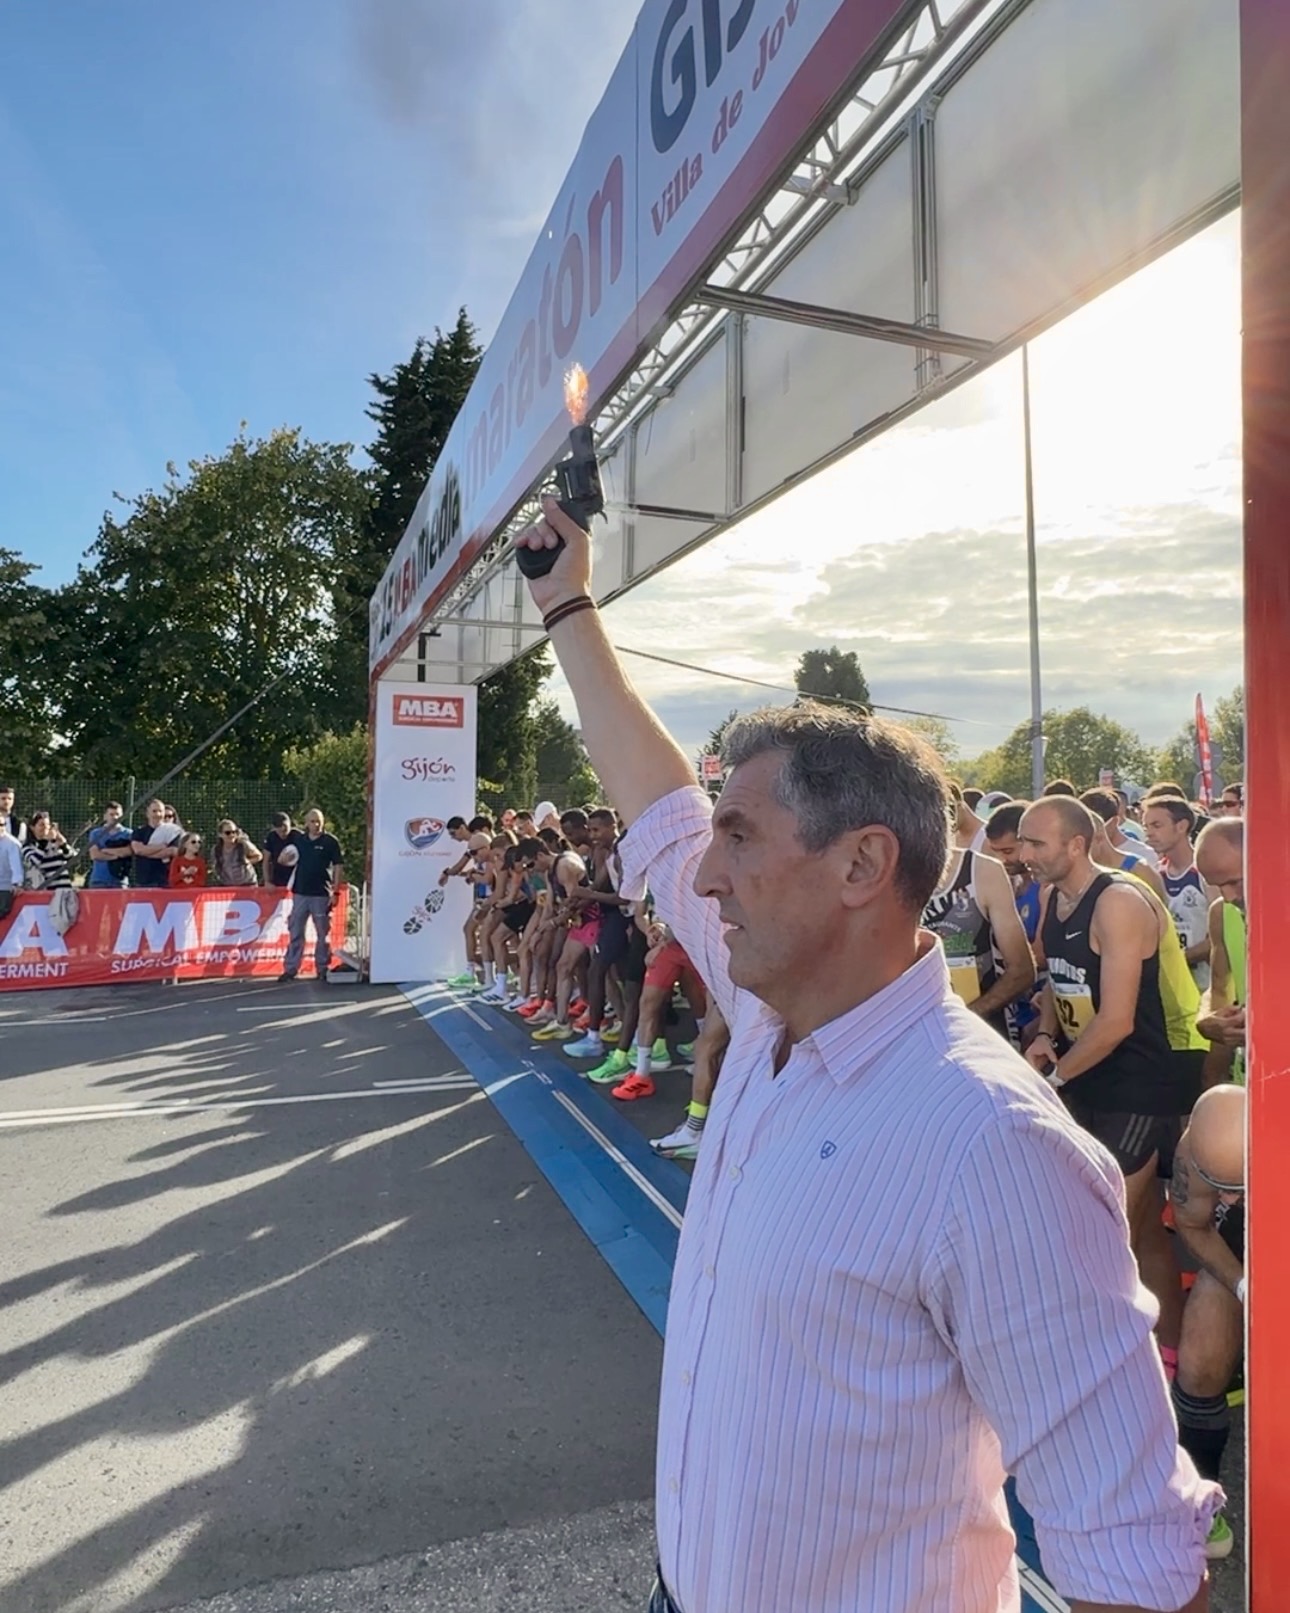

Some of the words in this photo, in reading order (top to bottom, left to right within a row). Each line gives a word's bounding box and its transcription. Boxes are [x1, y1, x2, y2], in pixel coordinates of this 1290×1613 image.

[651, 152, 704, 236] Villa
[711, 89, 743, 154] de
[464, 154, 625, 512] maratón
[398, 699, 458, 718] MBA
[401, 757, 456, 782] gijón
[112, 898, 318, 955] MBA
